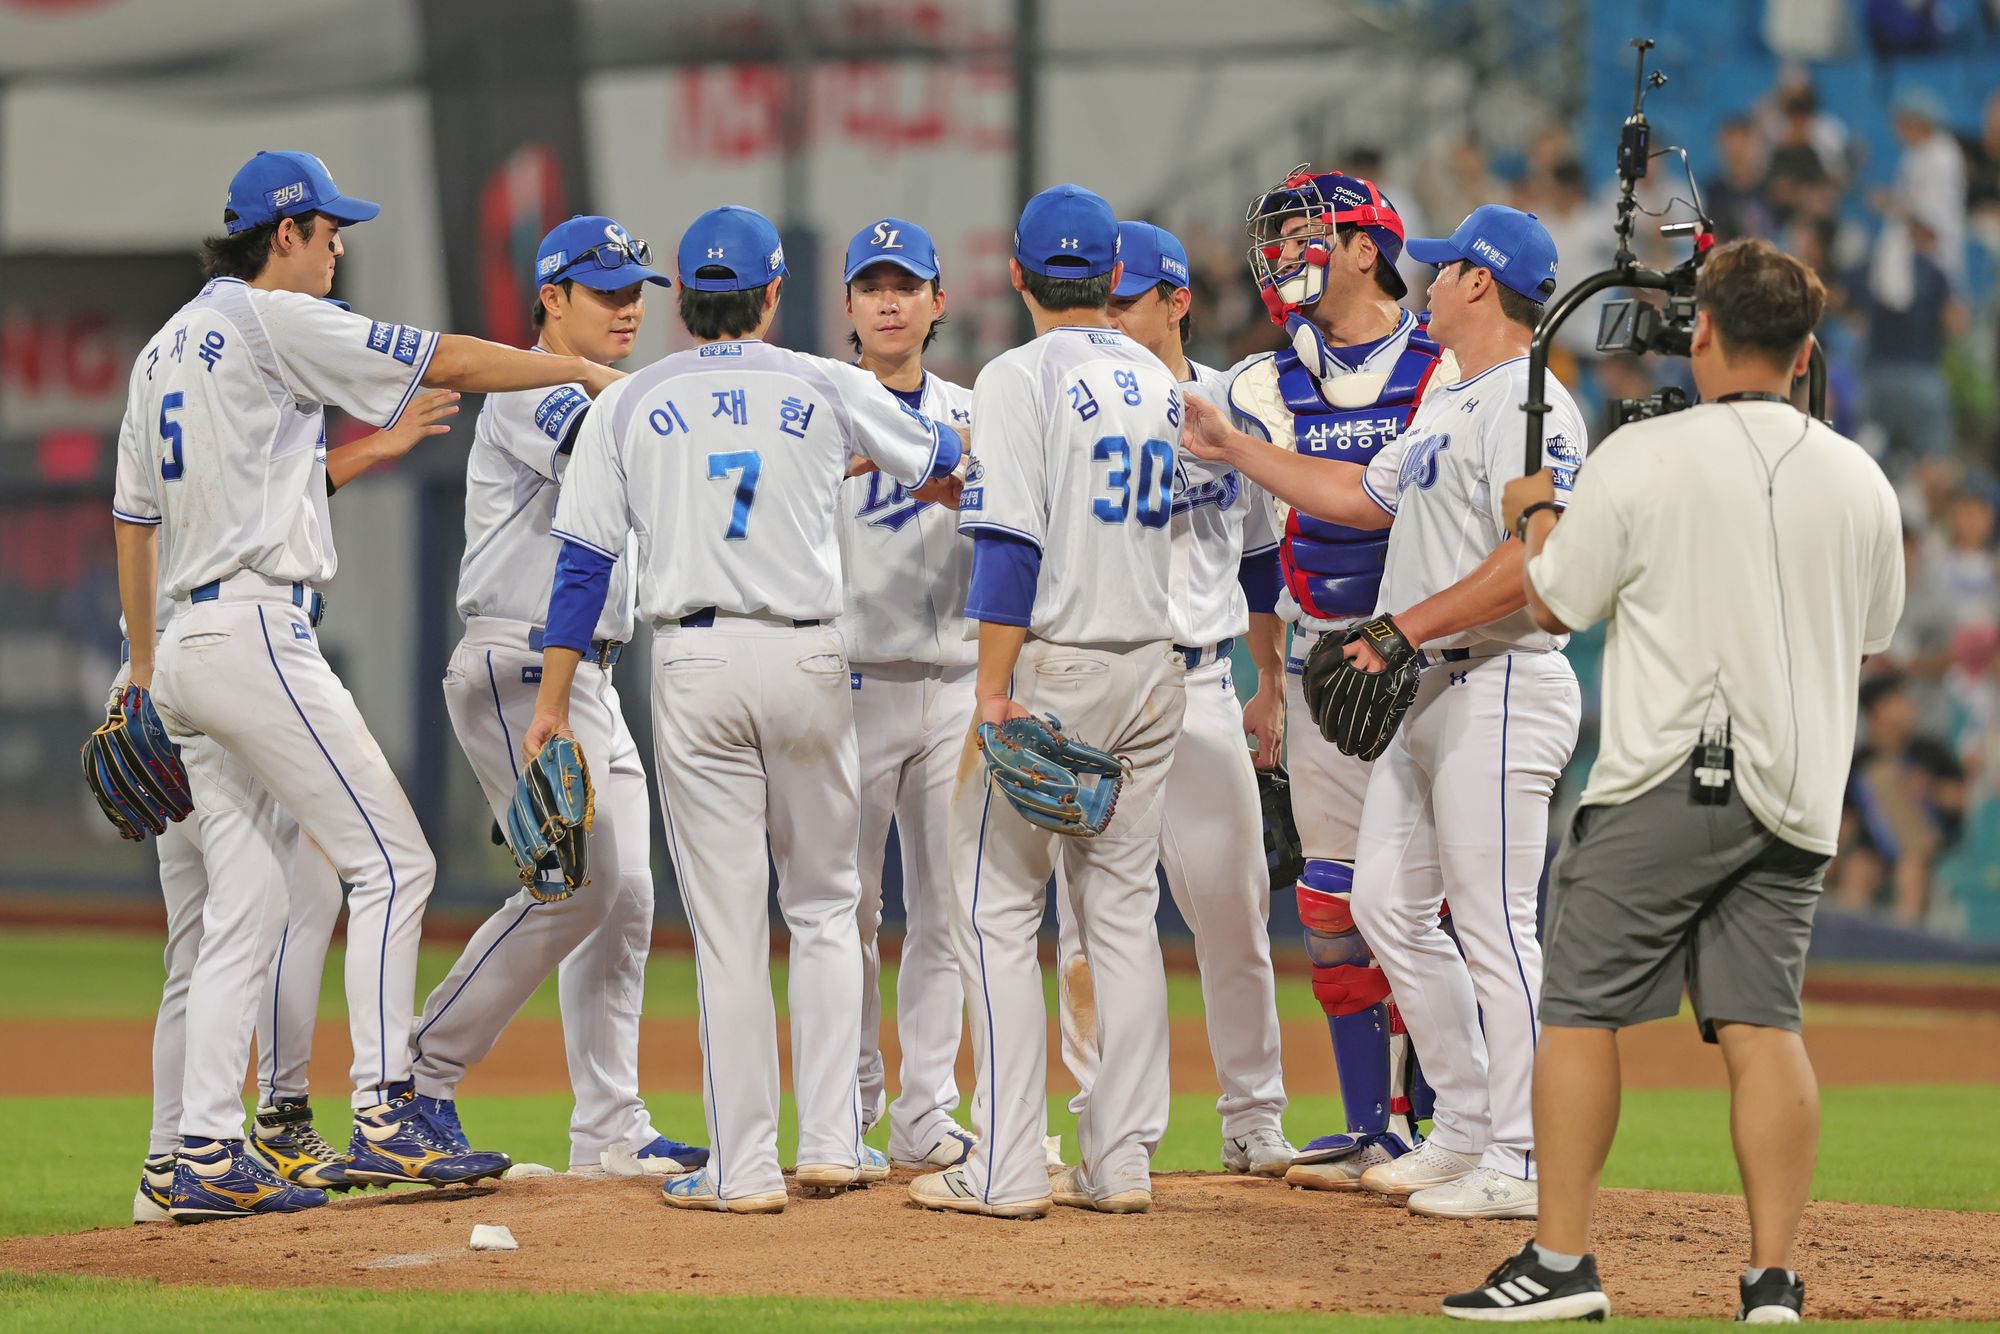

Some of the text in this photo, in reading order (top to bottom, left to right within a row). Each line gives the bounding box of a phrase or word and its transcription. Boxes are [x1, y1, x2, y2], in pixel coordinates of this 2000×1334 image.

[273, 182, 304, 207] 켈리
[1332, 193, 1362, 207] Z Fold
[1335, 186, 1367, 204] Galaxy
[870, 221, 904, 249] SL
[1473, 238, 1508, 268] iM뱅크
[535, 387, 575, 424] 대구대학교
[159, 390, 185, 483] 5
[1304, 416, 1398, 452] 삼성증권
[707, 449, 765, 541] 7
[1091, 435, 1175, 530] 30
